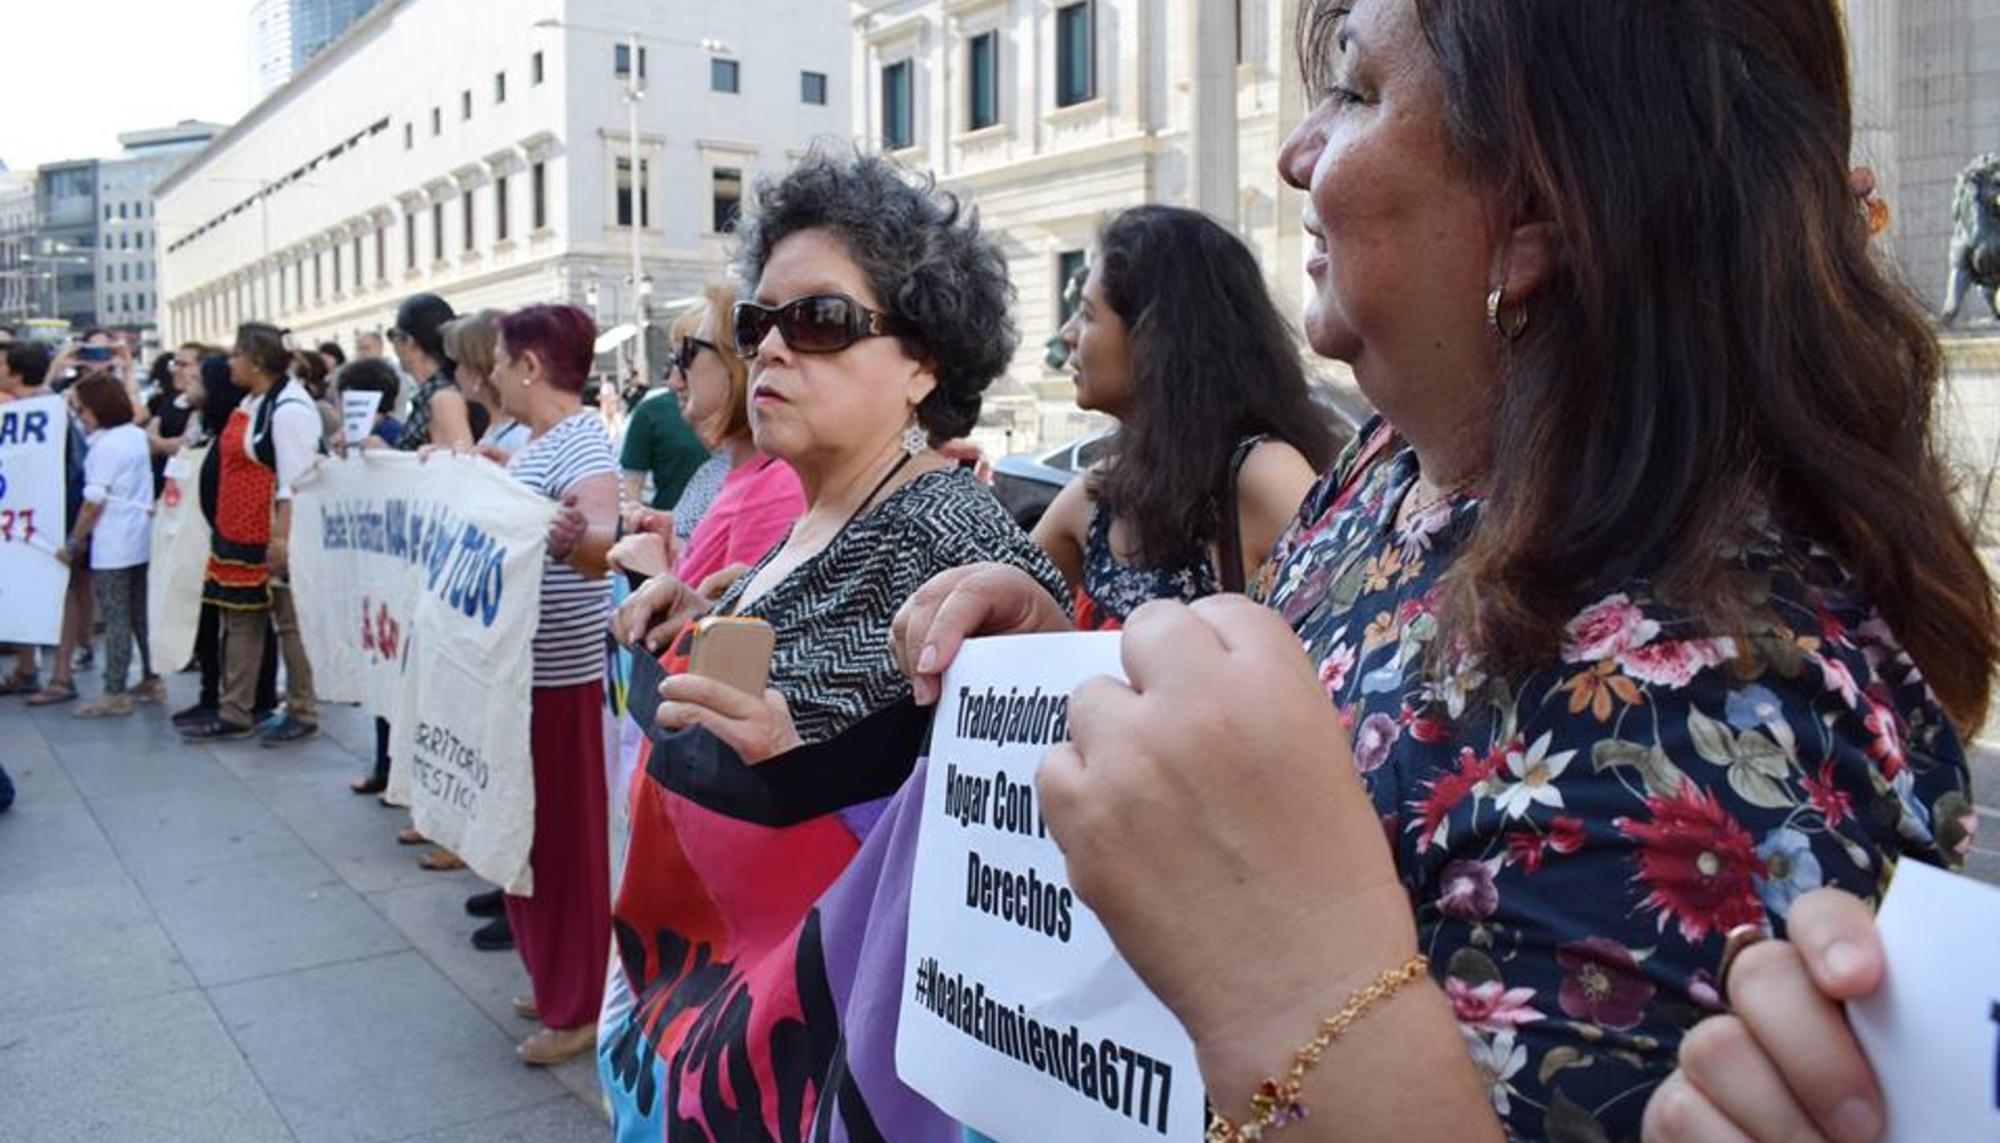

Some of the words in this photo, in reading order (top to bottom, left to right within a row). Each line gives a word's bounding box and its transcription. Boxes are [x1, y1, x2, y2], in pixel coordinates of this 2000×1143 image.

[956, 685, 1073, 747] Trabajadora
[945, 763, 991, 828] Hogar
[993, 770, 1032, 836] Con
[966, 850, 1073, 943] Derechos
[915, 956, 1172, 1135] #NoalaEnmienda6777
